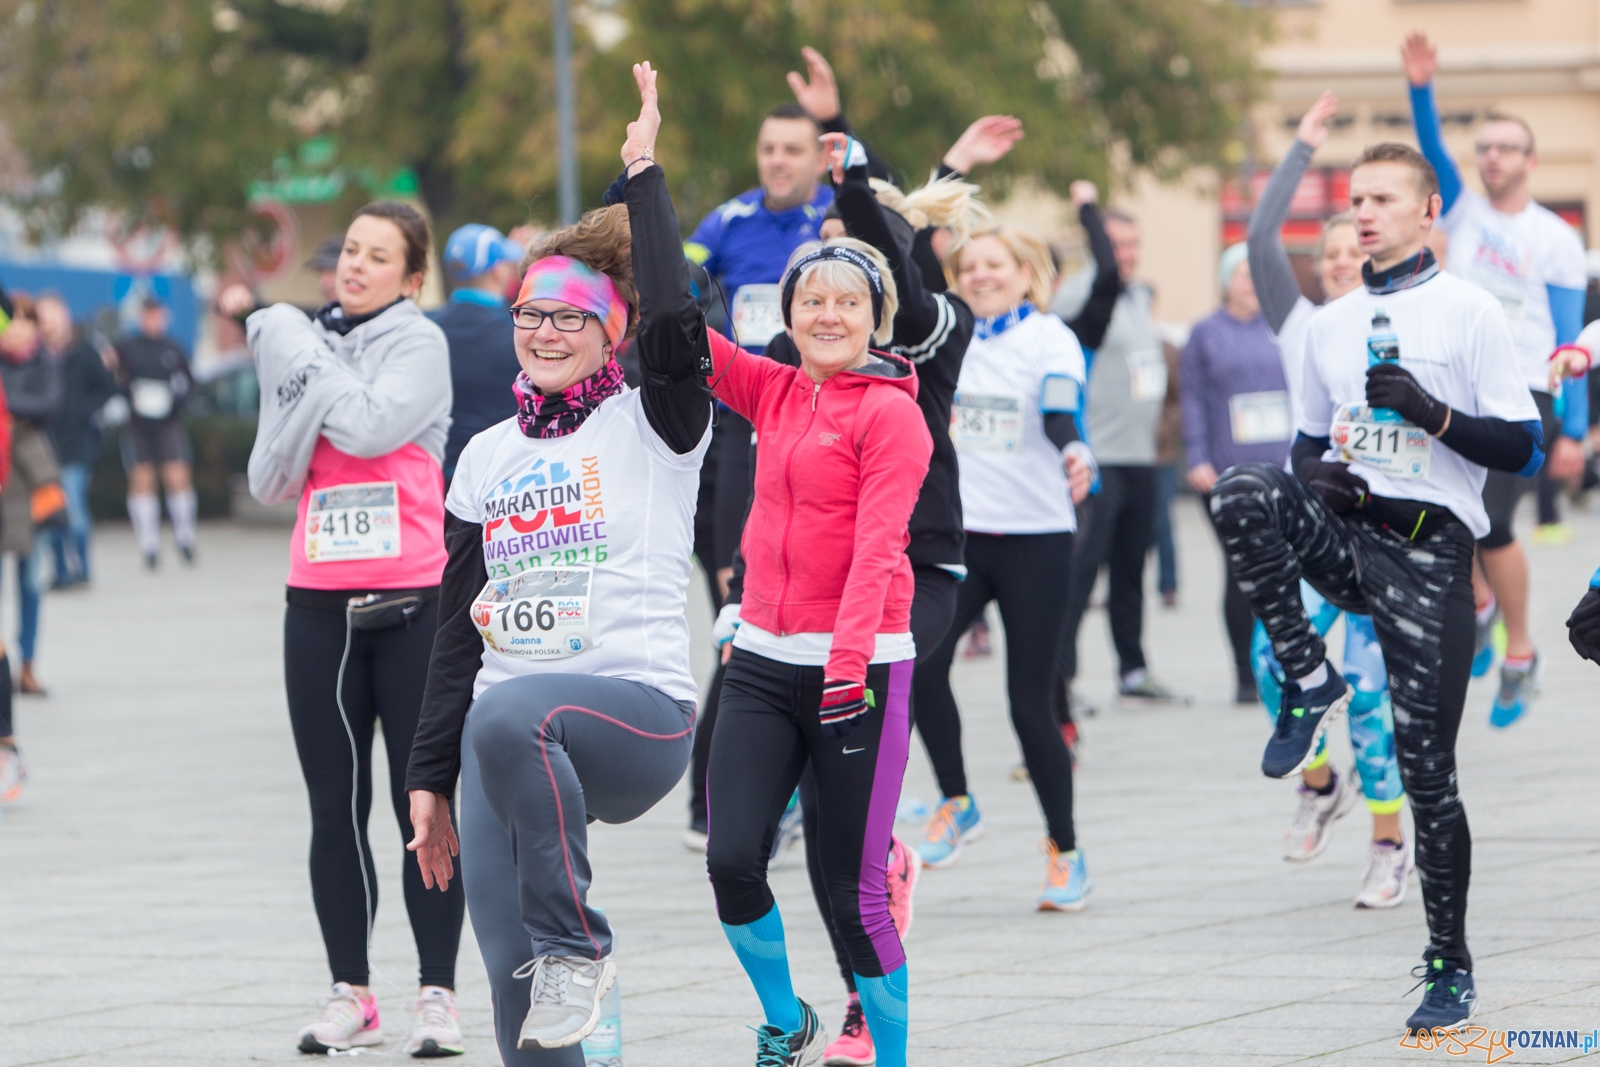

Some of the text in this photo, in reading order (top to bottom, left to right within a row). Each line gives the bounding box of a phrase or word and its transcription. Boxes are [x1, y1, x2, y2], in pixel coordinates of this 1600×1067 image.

[1353, 426, 1400, 454] 211
[484, 482, 581, 520] MARATON
[581, 455, 605, 520] SKOKI
[322, 510, 371, 536] 418
[484, 520, 608, 562] WĄGROWIEC
[510, 636, 542, 645] Joanna
[534, 648, 561, 656] POLSKA
